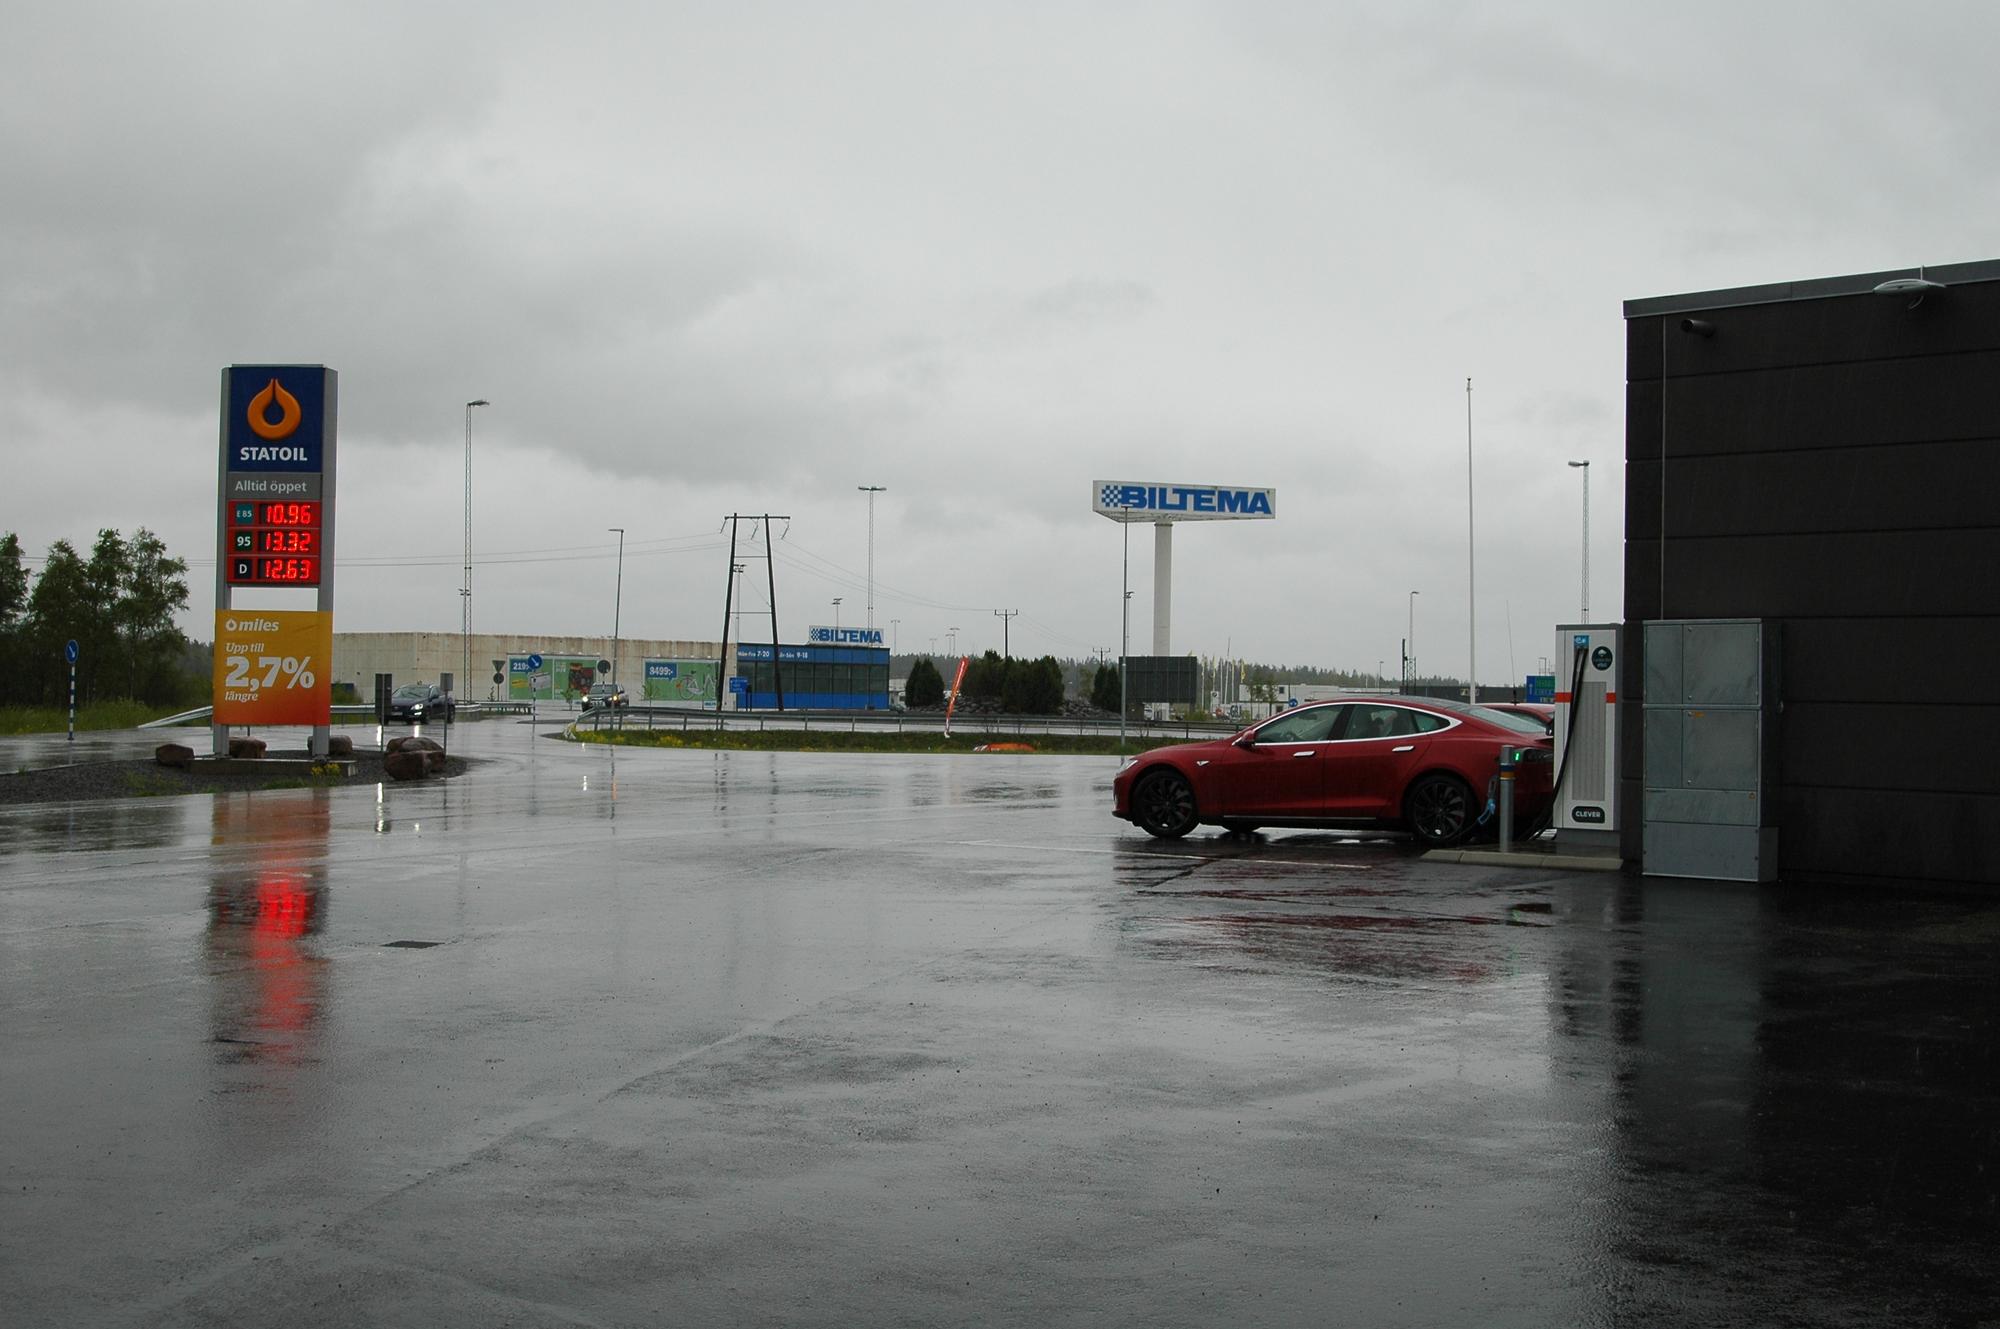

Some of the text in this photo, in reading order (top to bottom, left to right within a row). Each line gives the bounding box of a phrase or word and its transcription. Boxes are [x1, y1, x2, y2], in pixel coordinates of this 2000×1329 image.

[240, 447, 308, 462] STATOIL
[235, 480, 307, 495] Alltid öppet
[1121, 485, 1272, 515] BILTEMA
[242, 510, 252, 518] 85
[267, 504, 311, 524] 10.96
[236, 536, 251, 547] 95
[266, 532, 311, 552] 13.32
[239, 564, 248, 574] D
[265, 560, 310, 579] 12.63
[238, 618, 279, 632] miles
[820, 629, 882, 643] BILTEMA
[225, 642, 264, 655] Upp till
[225, 656, 315, 692] 2,7%
[224, 691, 258, 703] längre
[1575, 810, 1600, 818] CLEVER
